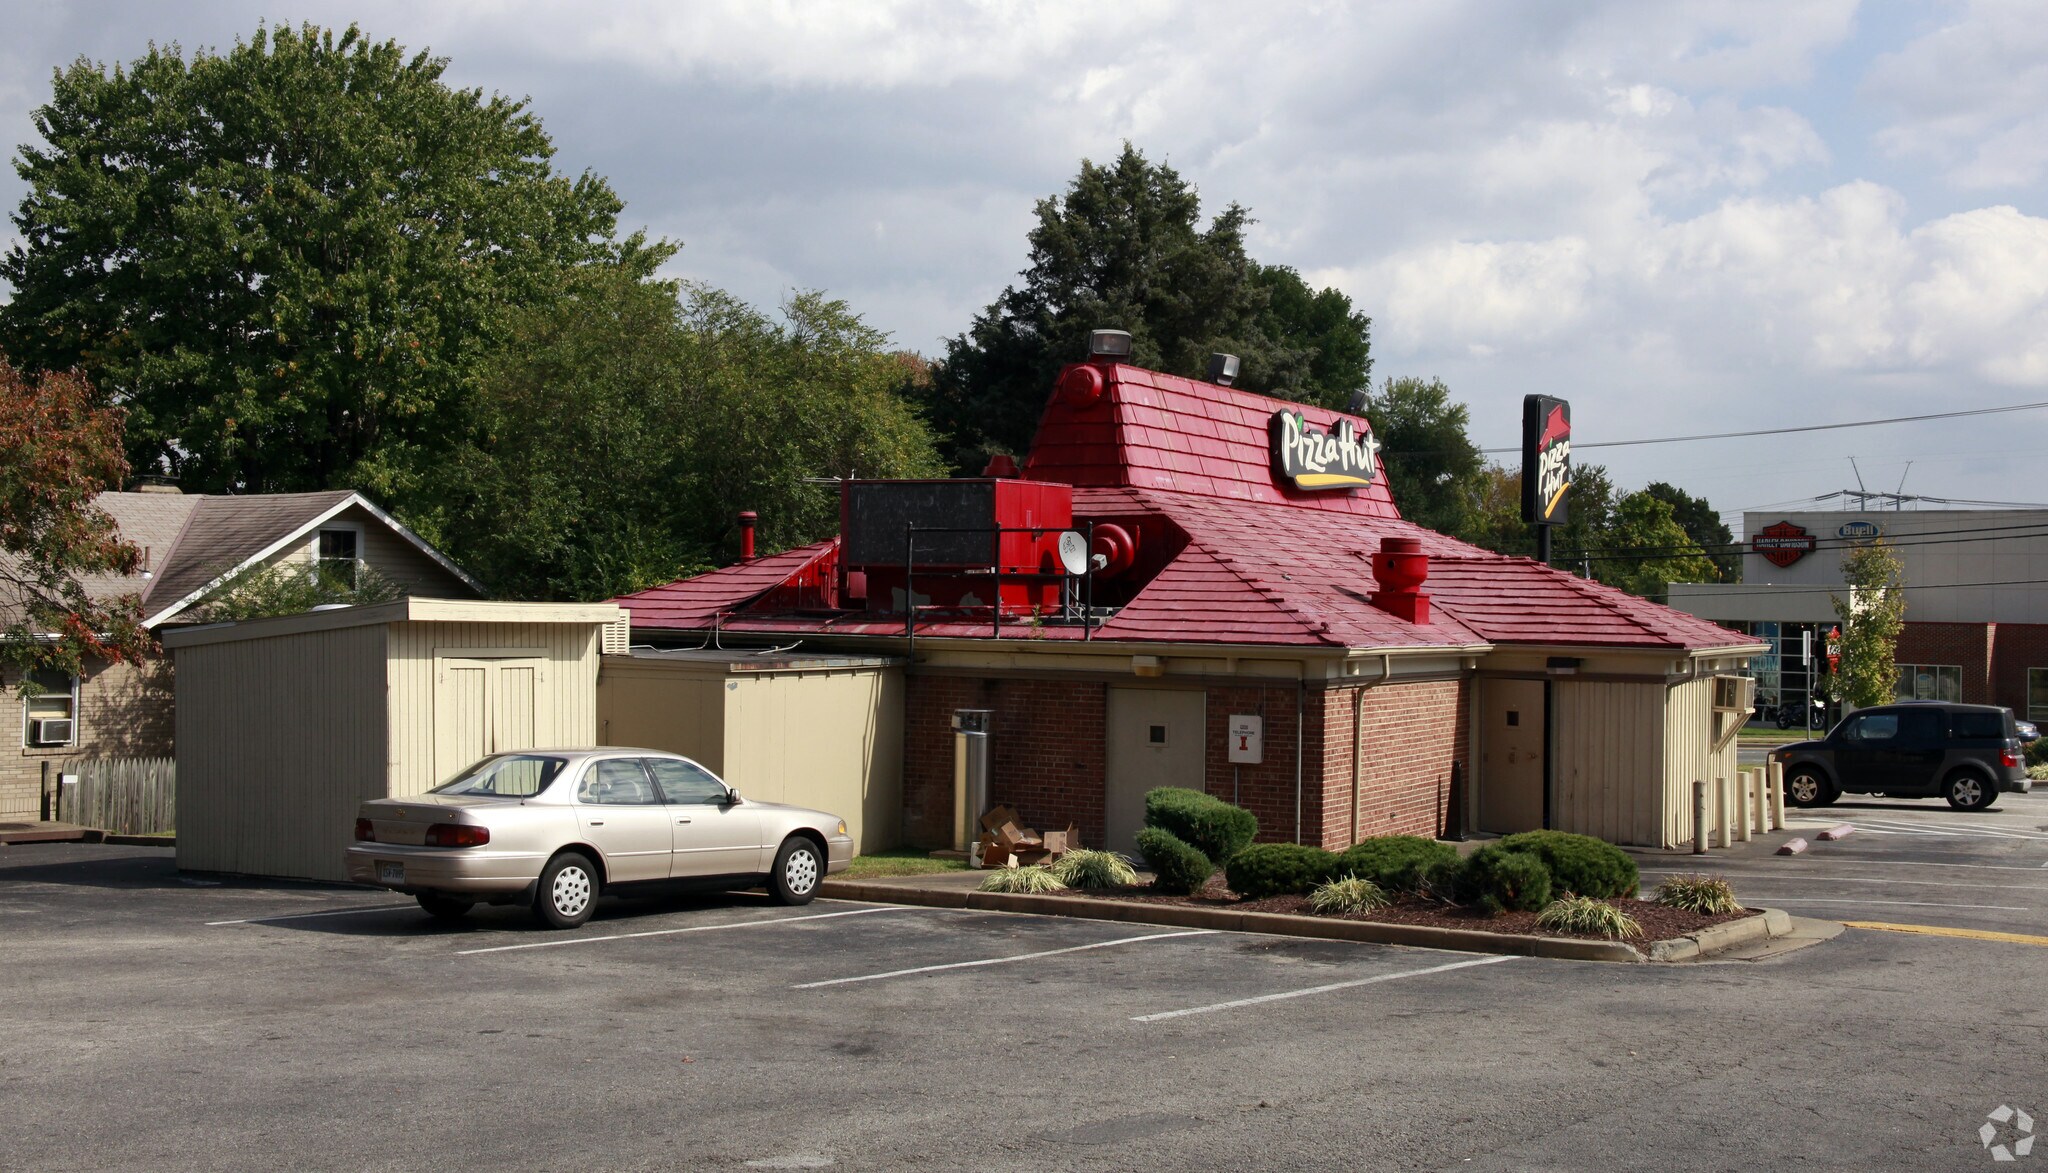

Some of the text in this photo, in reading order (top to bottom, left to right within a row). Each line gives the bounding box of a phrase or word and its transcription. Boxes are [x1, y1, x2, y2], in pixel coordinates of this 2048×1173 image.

[1282, 412, 1381, 473] Pizza Hut
[1538, 438, 1571, 496] Pizza
[1543, 462, 1568, 506] Hut
[1843, 525, 1874, 537] Buell
